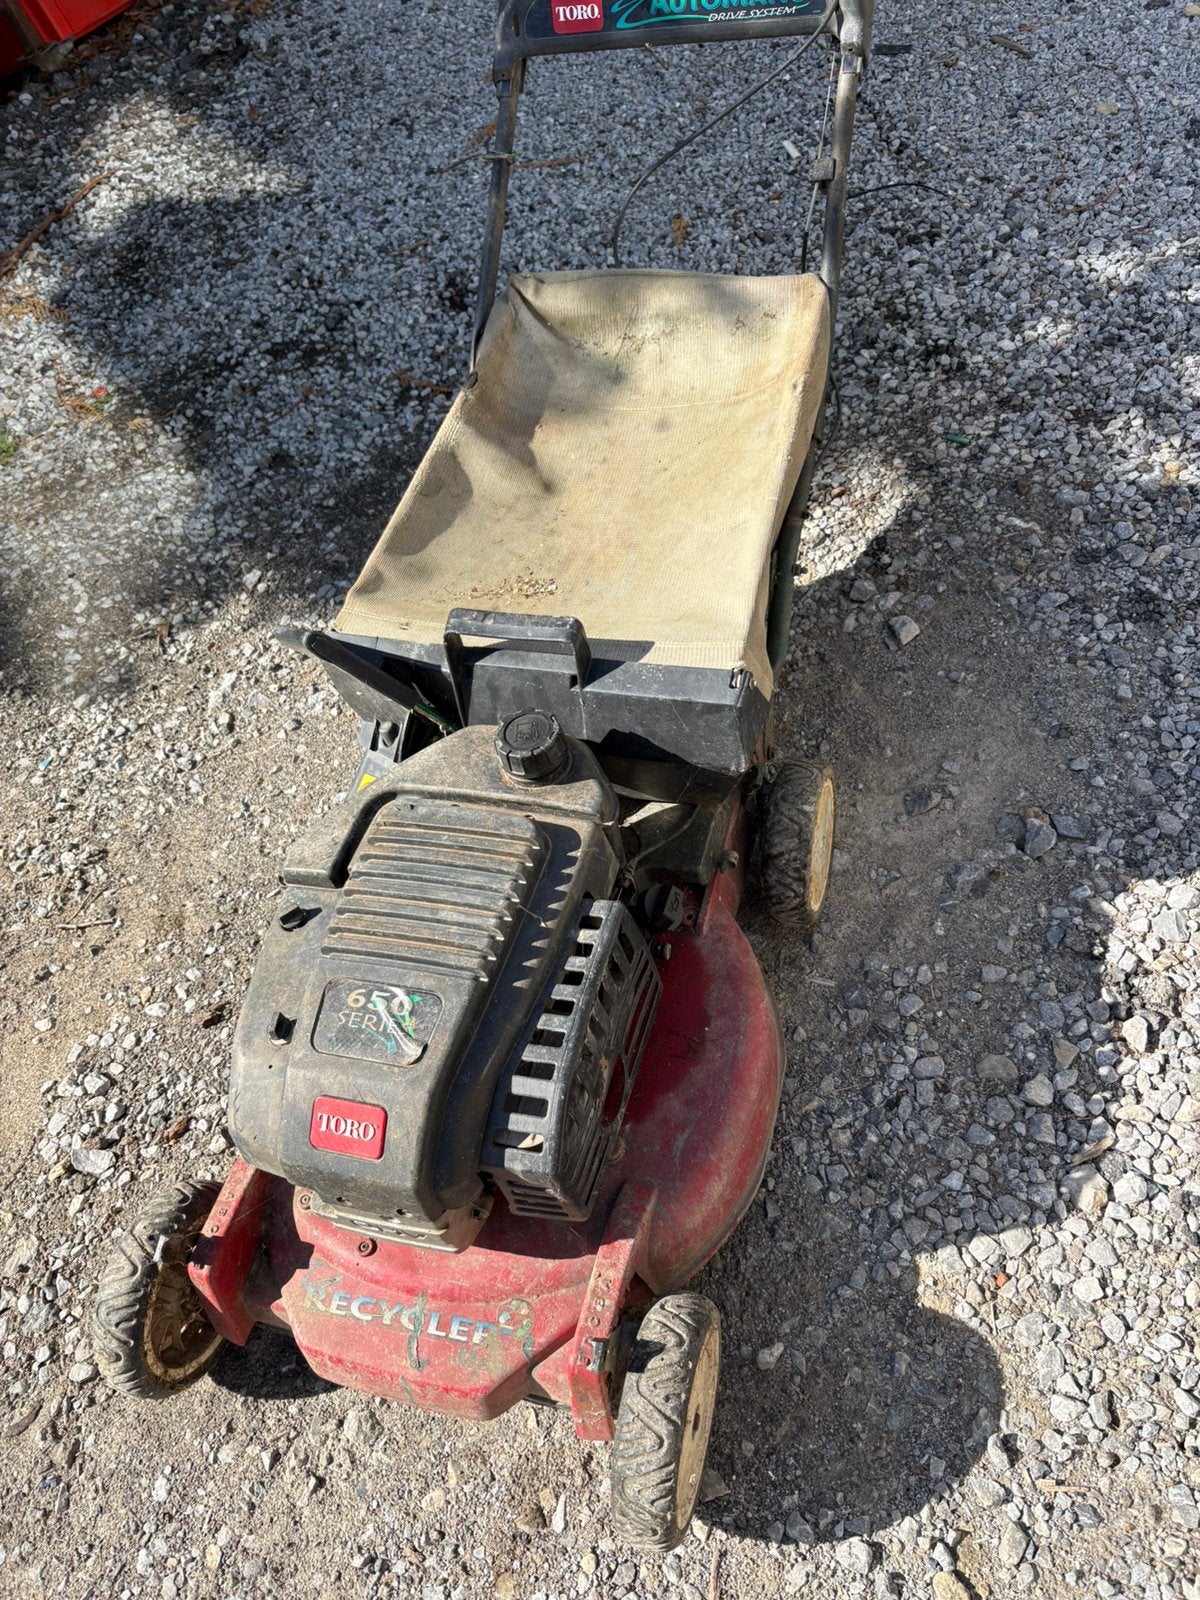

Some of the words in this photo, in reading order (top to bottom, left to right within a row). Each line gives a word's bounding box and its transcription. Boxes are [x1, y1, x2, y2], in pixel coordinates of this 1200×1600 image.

[555, 3, 599, 22] TORO
[708, 10, 747, 22] DRIVE
[749, 5, 797, 18] SYSTEM
[347, 988, 413, 1016] 650
[316, 1112, 376, 1142] TORO
